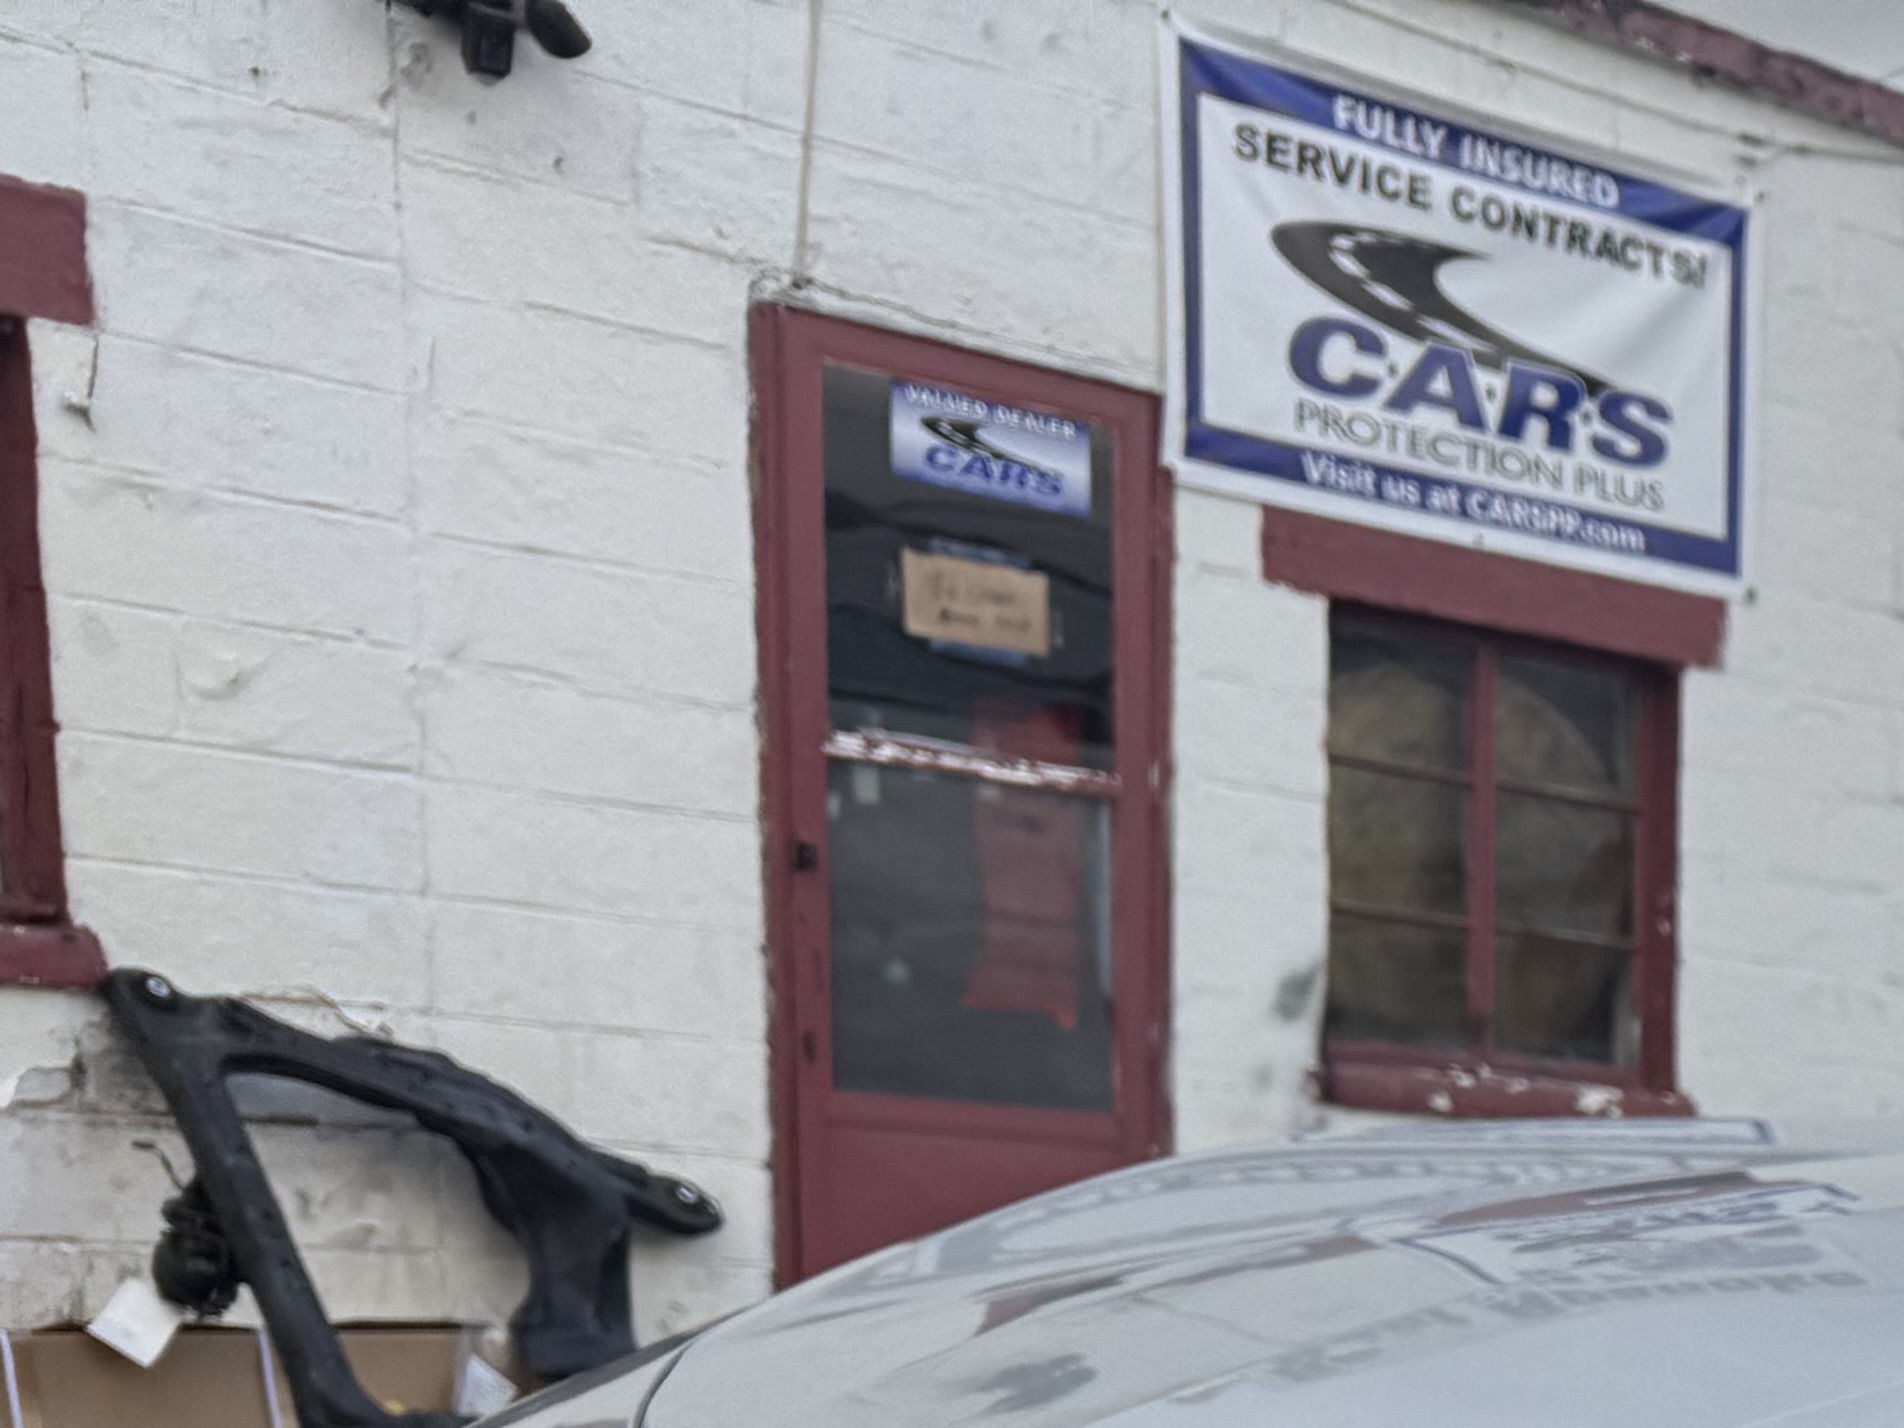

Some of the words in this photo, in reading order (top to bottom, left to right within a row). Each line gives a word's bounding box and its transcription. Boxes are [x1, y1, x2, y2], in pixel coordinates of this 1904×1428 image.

[1232, 122, 1434, 211] SERVICE
[1448, 183, 1709, 290] CONTRACTS!
[1331, 93, 1448, 161] FULLY
[1459, 132, 1620, 209] INSURED
[905, 384, 987, 419] VALUED
[992, 403, 1077, 440] DEALER
[1294, 399, 1564, 490] PROTECTION
[1573, 463, 1665, 514] PLUS
[1302, 450, 1377, 497] Visit
[1380, 475, 1421, 506] us
[1424, 483, 1462, 515] at
